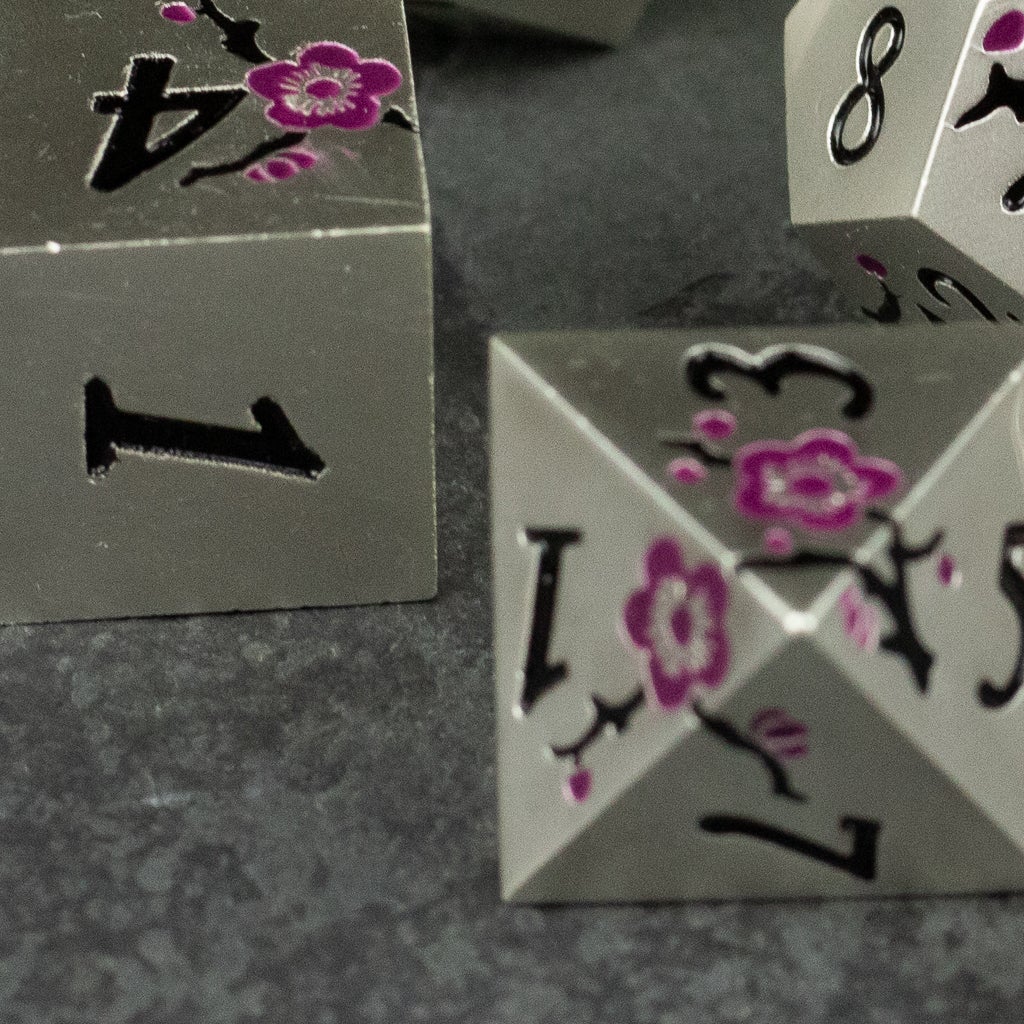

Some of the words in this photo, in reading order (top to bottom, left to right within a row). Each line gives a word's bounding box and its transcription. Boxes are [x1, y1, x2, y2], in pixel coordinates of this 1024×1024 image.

[88, 53, 249, 192] 4
[827, 5, 905, 167] 8
[83, 376, 327, 482] 1
[682, 342, 875, 418] 3
[513, 526, 582, 718] 1
[697, 814, 881, 882] 7
